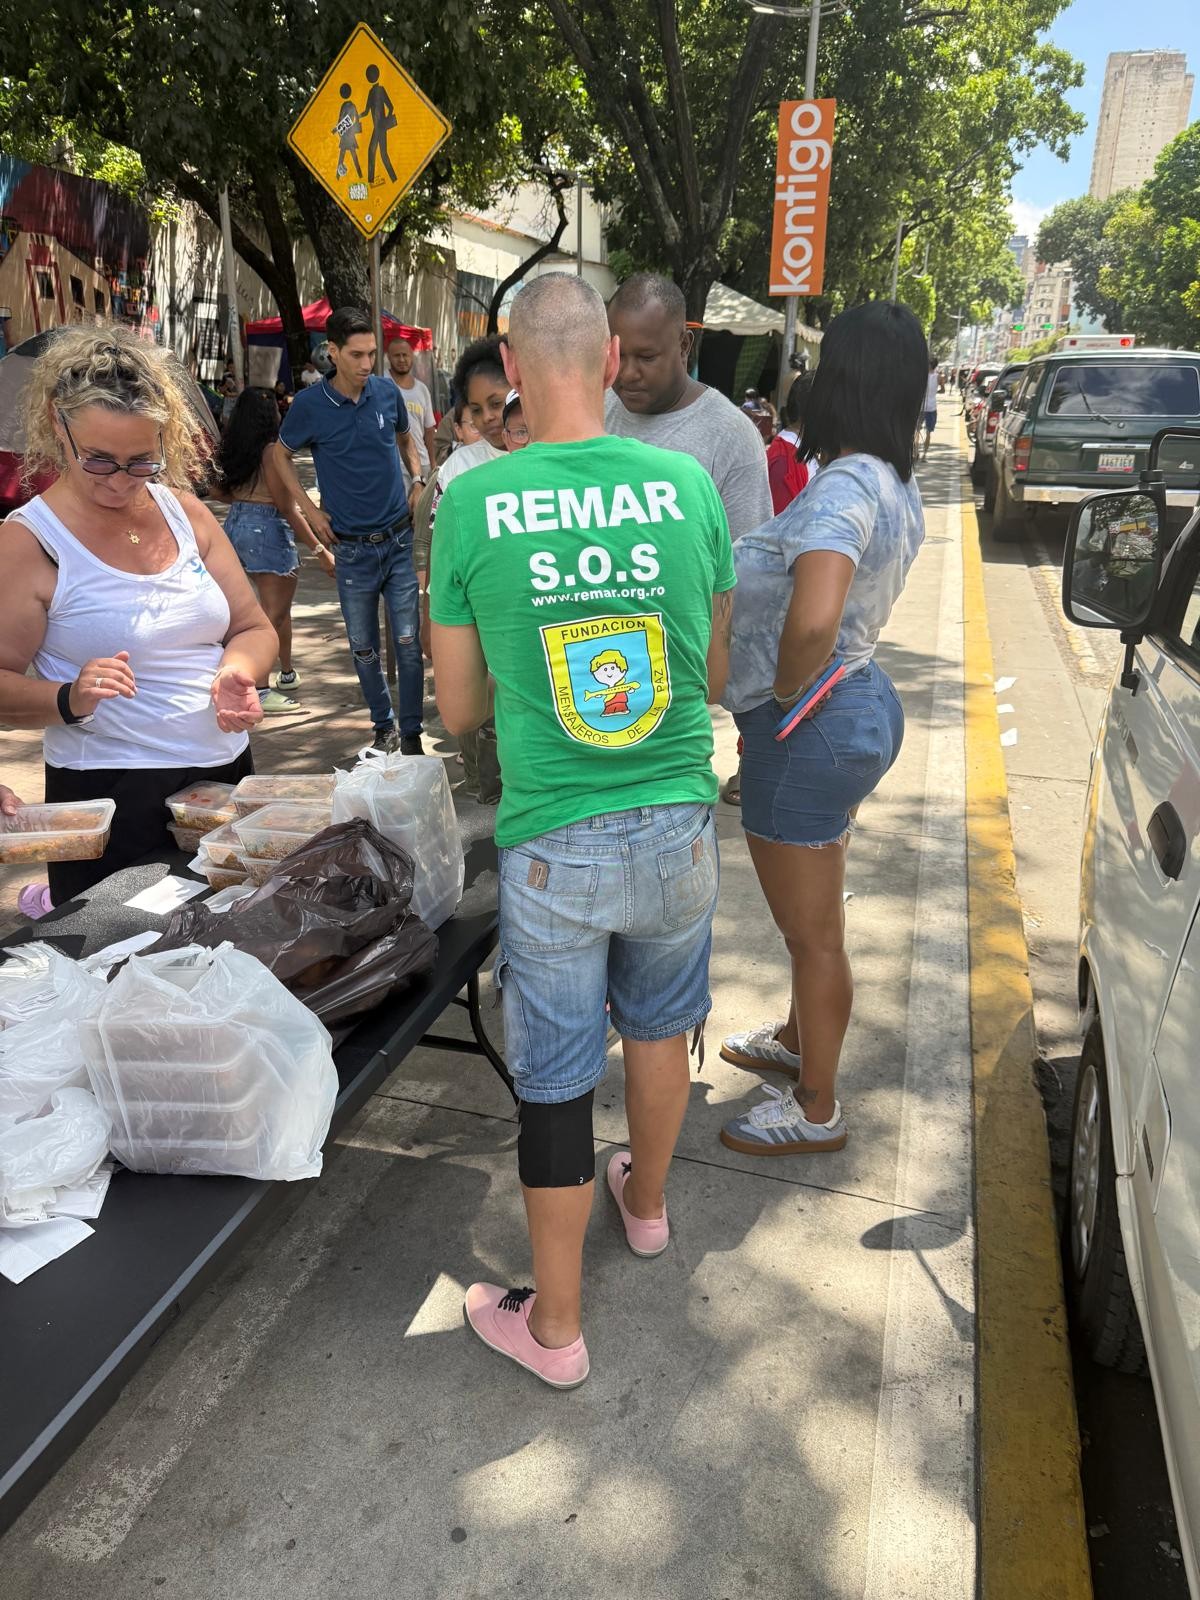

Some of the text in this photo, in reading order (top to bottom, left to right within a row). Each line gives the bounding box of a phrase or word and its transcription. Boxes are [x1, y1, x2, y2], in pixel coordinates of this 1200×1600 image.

[769, 103, 832, 293] kontigo
[485, 480, 685, 539] REMAR
[528, 543, 660, 591] S.O.S
[530, 585, 665, 607] www.remar.org.ro
[560, 619, 646, 641] FUNDACION
[558, 668, 665, 744] MENSAJEROS DE LA PAZ
